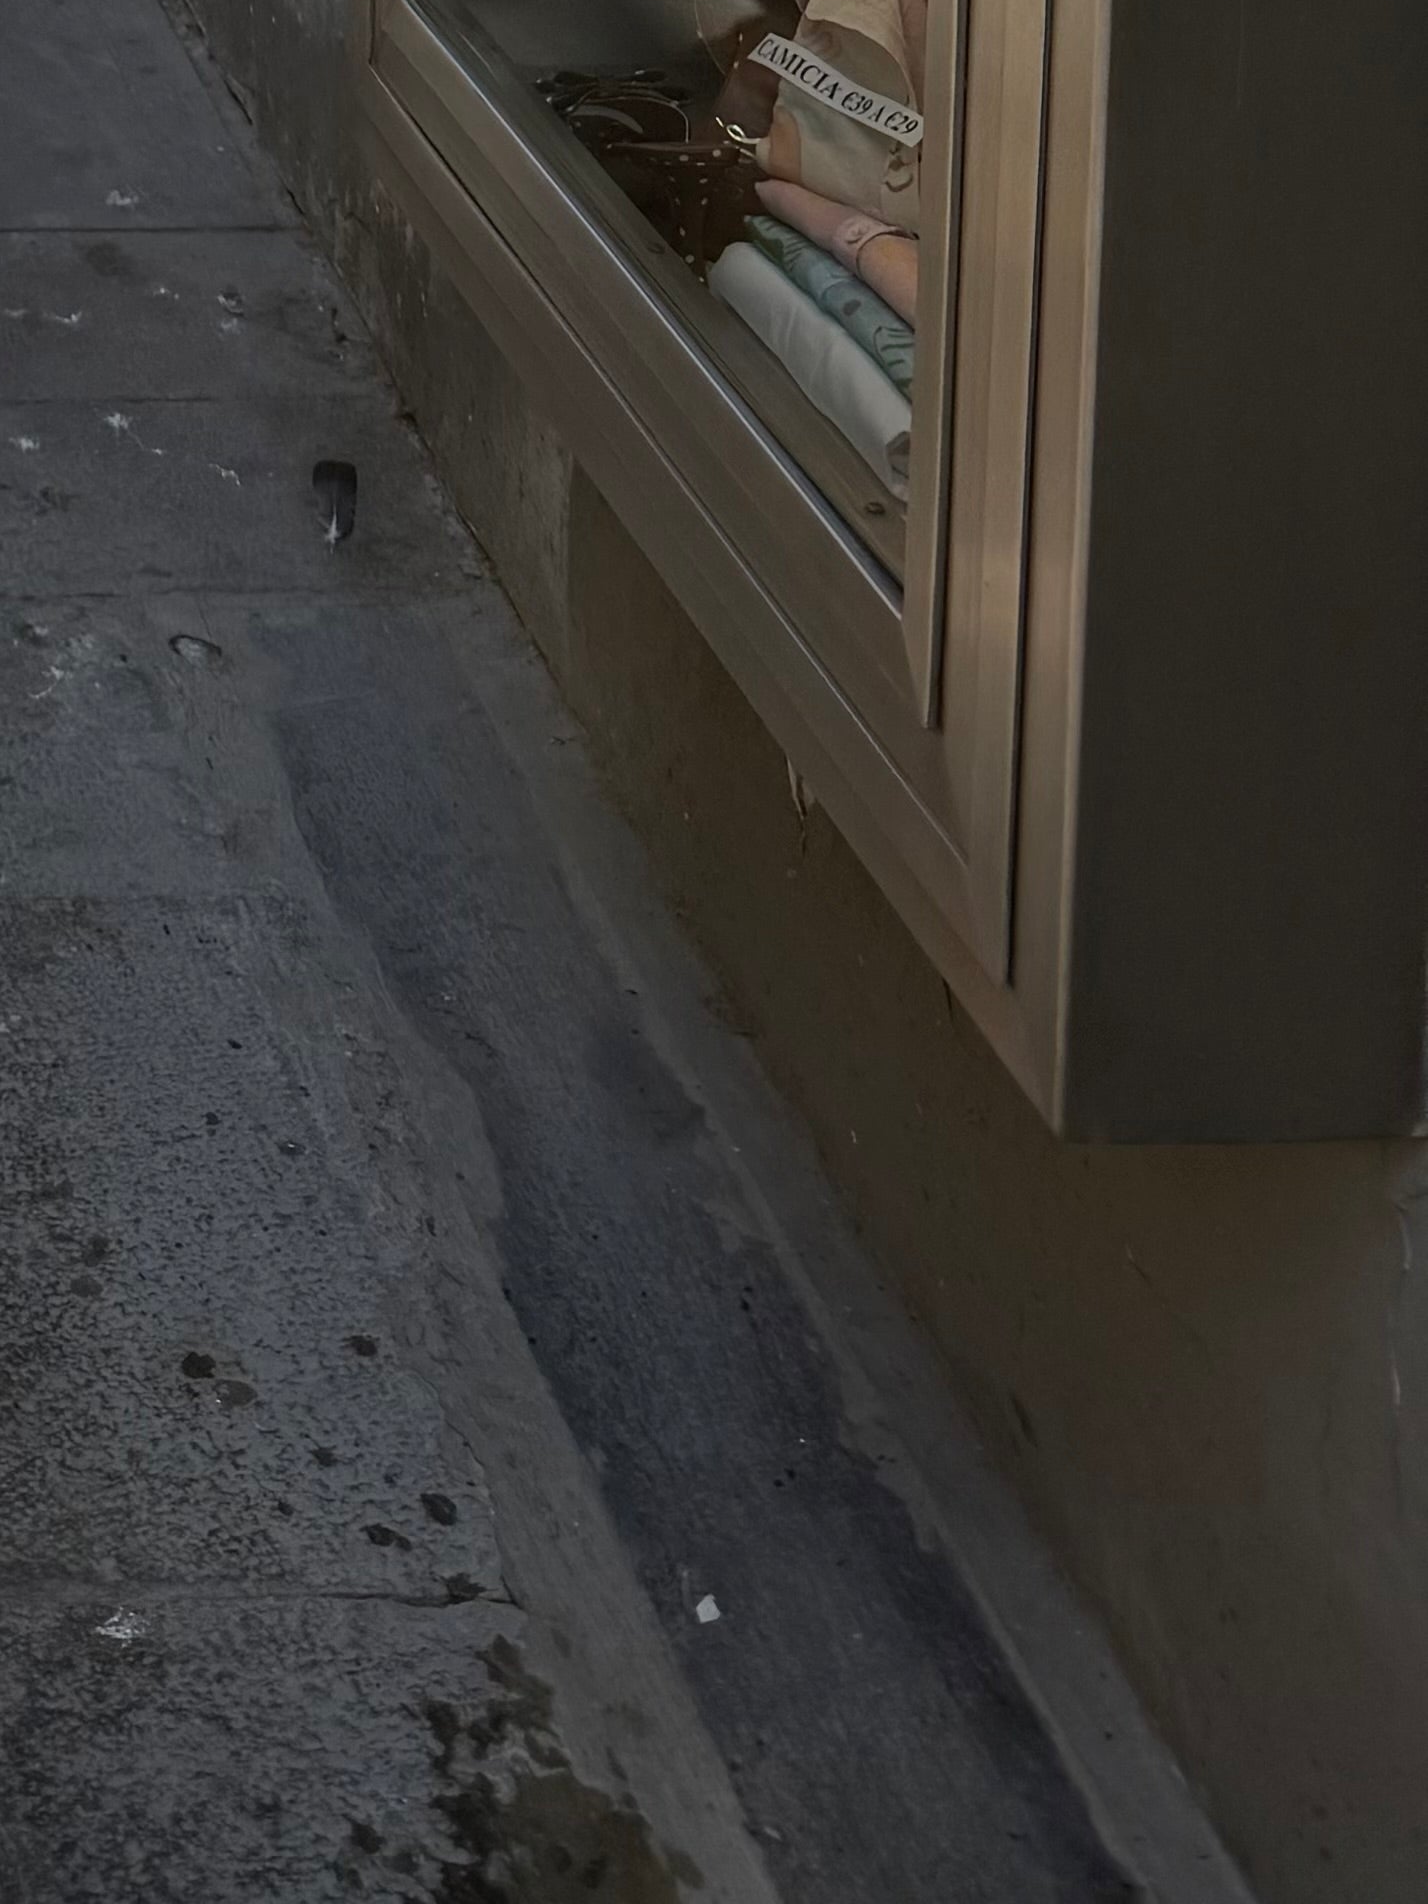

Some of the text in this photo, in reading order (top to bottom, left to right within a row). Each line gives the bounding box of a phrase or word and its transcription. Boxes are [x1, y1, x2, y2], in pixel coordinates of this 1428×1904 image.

[757, 38, 919, 135] CAMICIA €39 A €29
